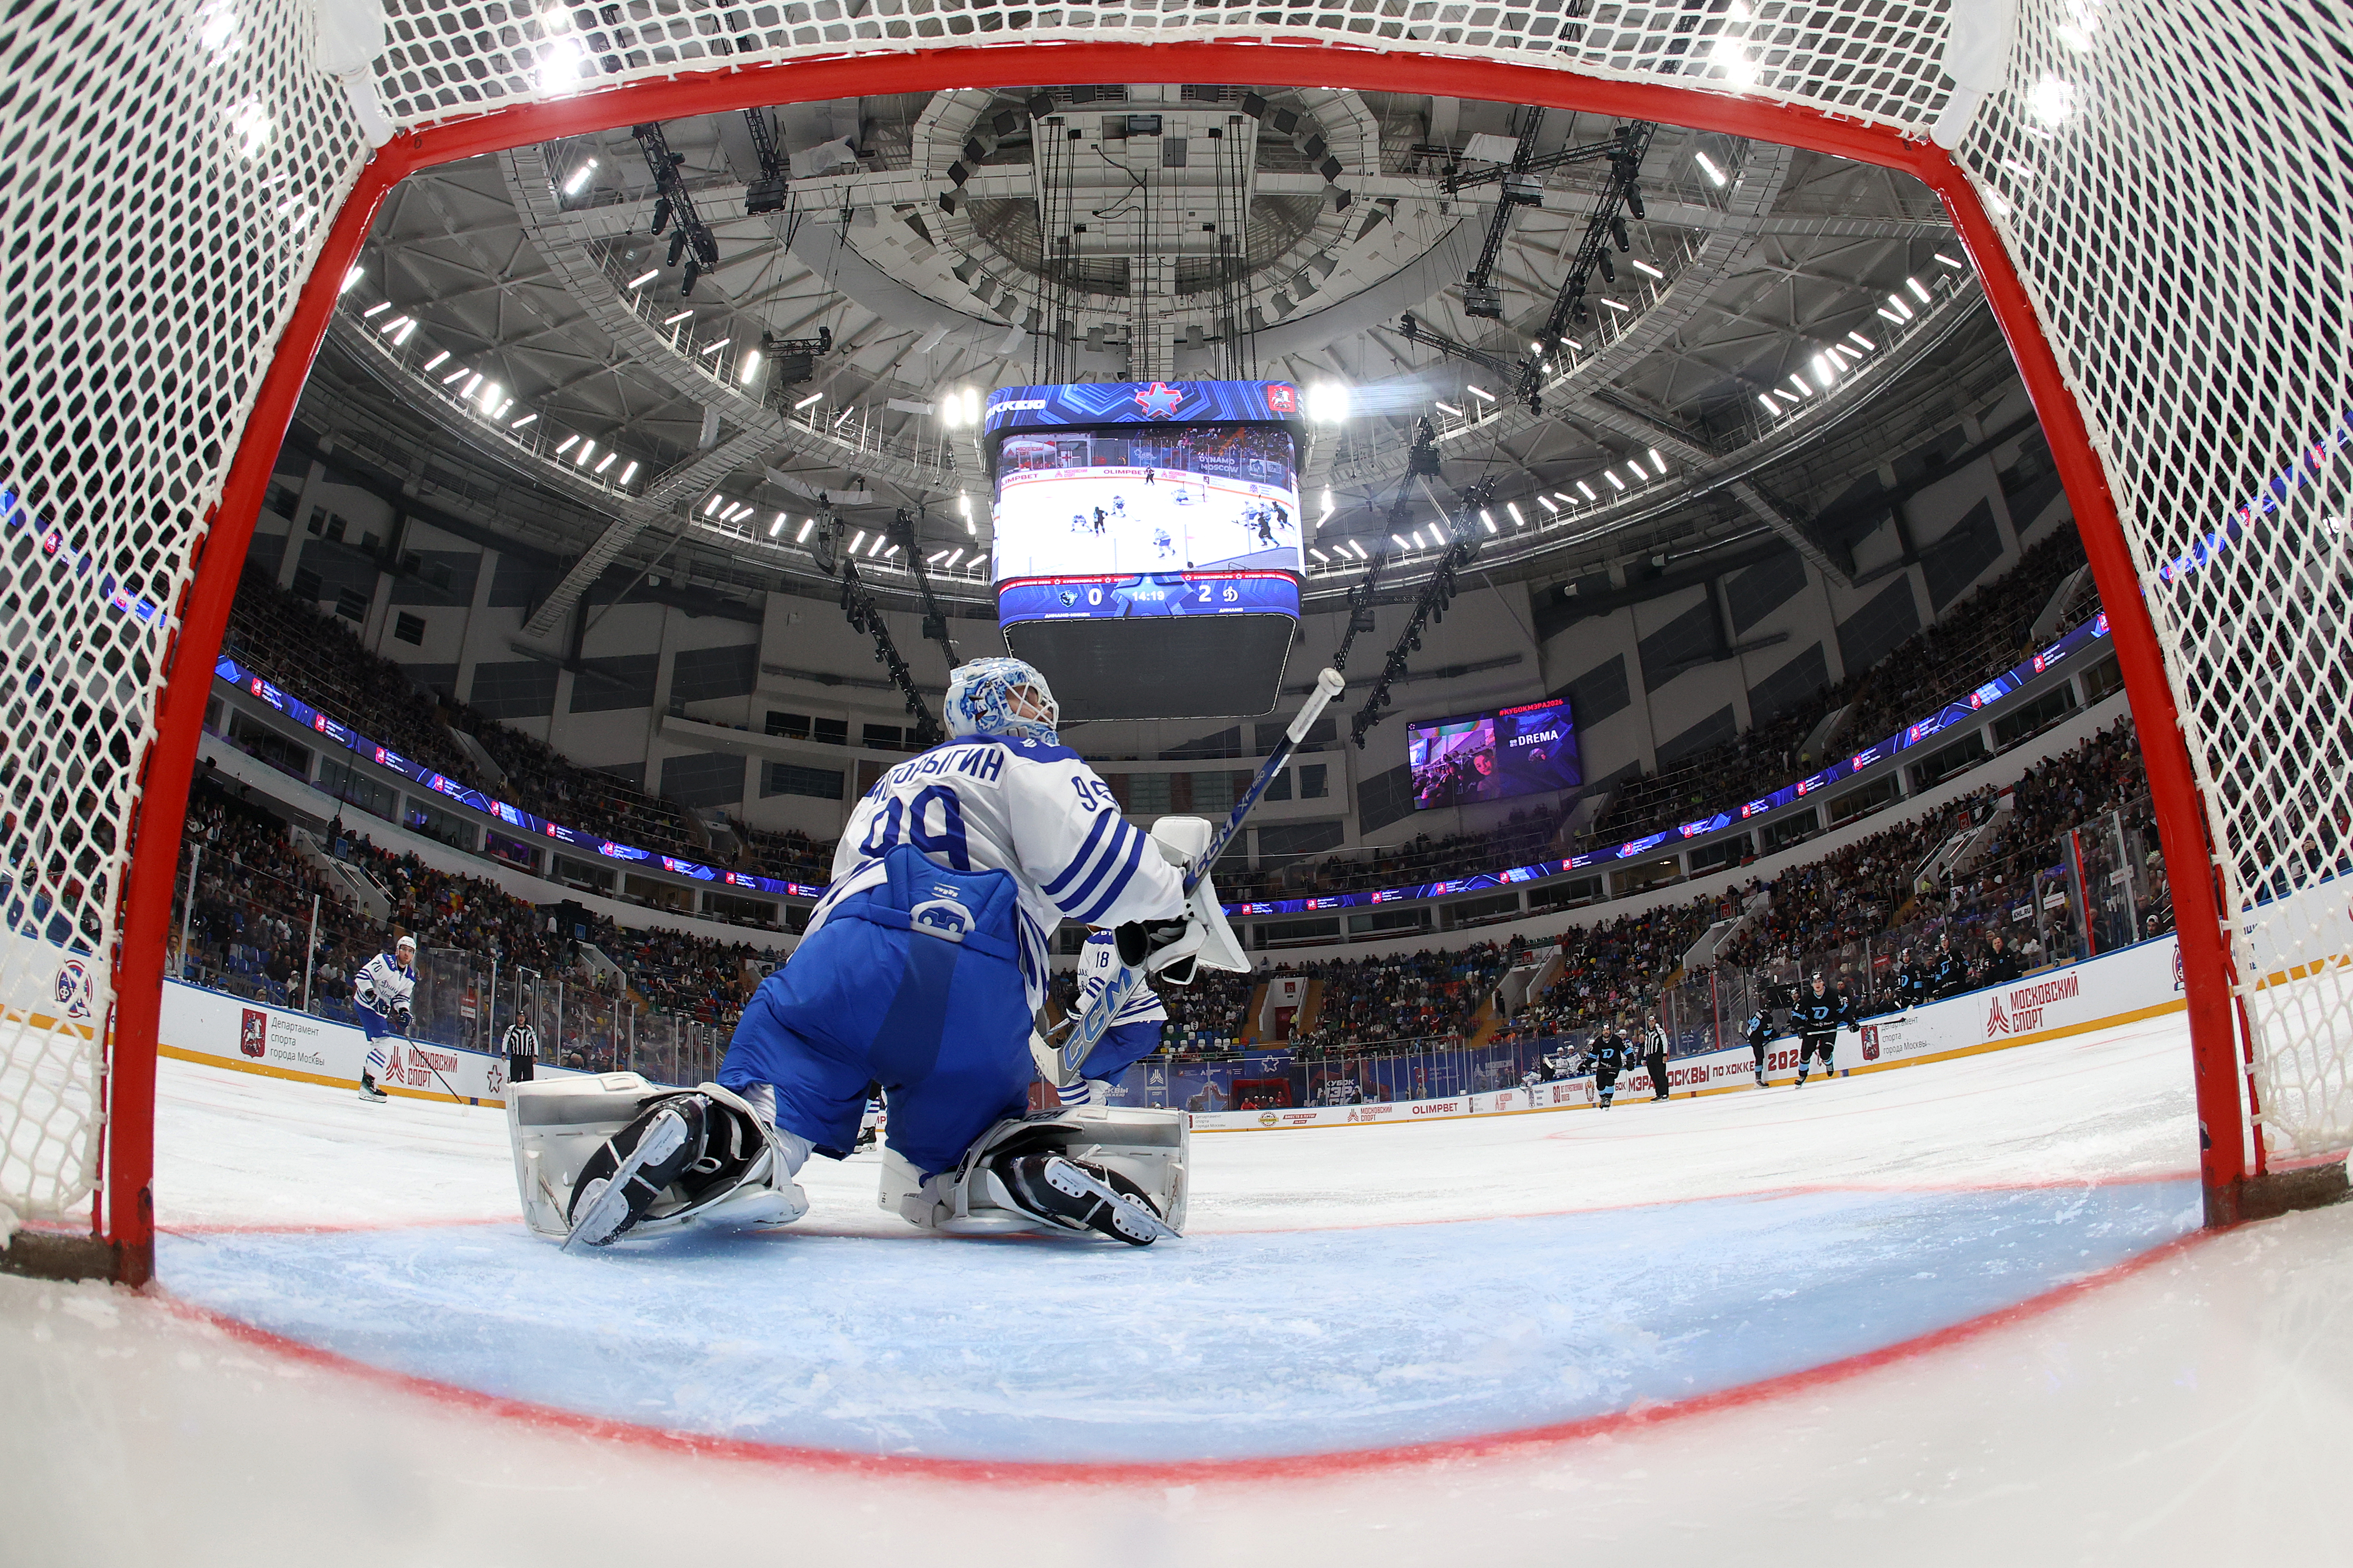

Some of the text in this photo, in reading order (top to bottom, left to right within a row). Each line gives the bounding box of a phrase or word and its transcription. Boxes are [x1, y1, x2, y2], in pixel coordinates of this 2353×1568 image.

[1199, 455, 1235, 465] DYNAMO
[1201, 464, 1239, 473] MOSCOW
[1001, 473, 1039, 486] LIMPBET
[1088, 588, 1102, 605] 0
[1132, 591, 1164, 601] 14:19
[1198, 585, 1212, 602] 2
[1499, 699, 1564, 716] #КУБОКМЭРА2026
[1518, 730, 1559, 746] DREMA
[1252, 770, 1266, 789] PRO
[1238, 787, 1253, 812] XF
[1195, 814, 1235, 878] CCM
[2013, 907, 2031, 919] KHL.RU
[371, 959, 383, 973] 70
[1095, 951, 1109, 968] 18
[2009, 971, 2079, 1011] МОСКОВСКИЙ
[272, 1017, 319, 1036] Департамент
[1063, 967, 1134, 1072] CCM
[2012, 1007, 2044, 1033] СПОРТ
[271, 1033, 296, 1047] спорта
[1882, 1032, 1902, 1043] спорта
[1883, 1039, 1927, 1055] города Москвы
[270, 1048, 325, 1066] города Москвы
[409, 1048, 458, 1073] МОСКОВСКИЙ
[1767, 1049, 1799, 1072] 202
[408, 1069, 432, 1088] СПОРТ
[1326, 1079, 1354, 1087] КУБОК
[1615, 1081, 1626, 1091] БОК
[1667, 1064, 1709, 1089] ОСКВЫ
[1725, 1060, 1755, 1076] ХОККЕ
[1553, 1085, 1560, 1103] 80
[1023, 1109, 1069, 1122] CCM
[1360, 1104, 1393, 1115] МОСКОВСКИЙ
[1412, 1103, 1458, 1115] OLIMPBET
[1361, 1114, 1377, 1122] СПОРТ
